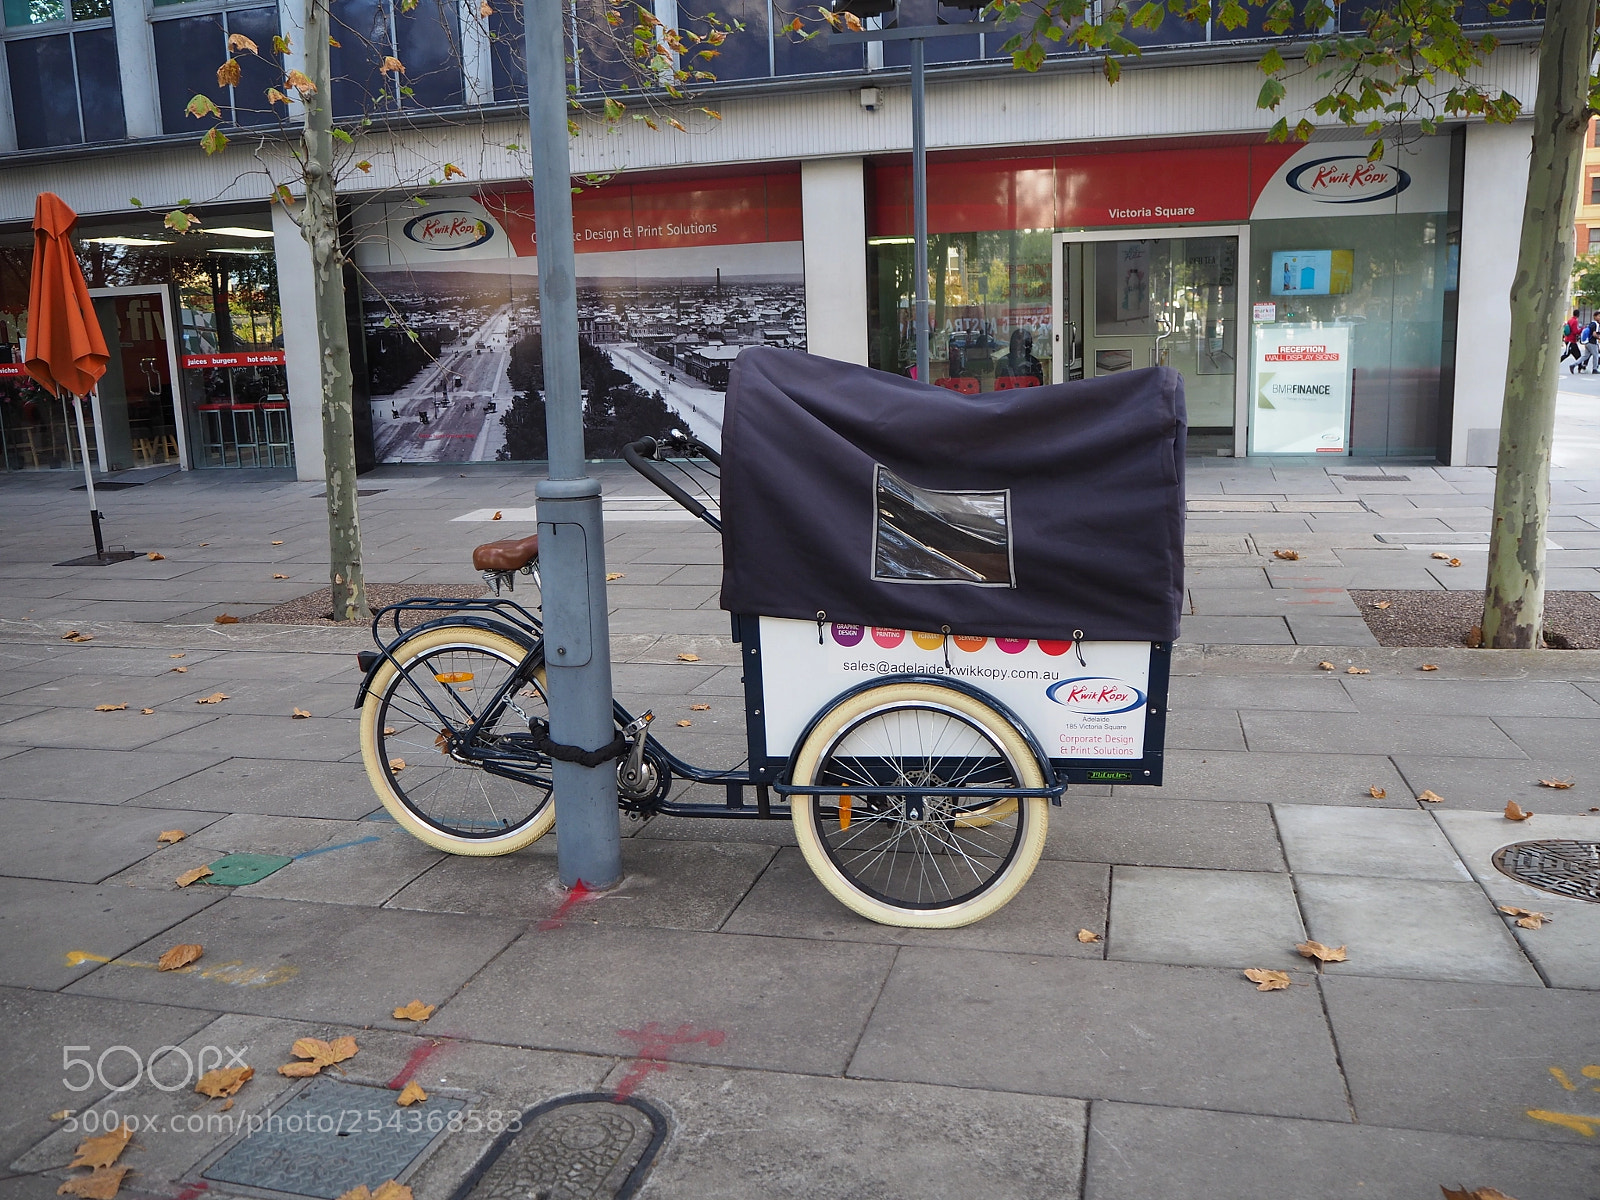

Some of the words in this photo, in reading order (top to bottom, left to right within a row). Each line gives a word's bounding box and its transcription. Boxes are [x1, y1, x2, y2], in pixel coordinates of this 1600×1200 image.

[1311, 165, 1350, 190] Kwik
[1348, 163, 1389, 189] Kopy
[1108, 207, 1152, 218] Victoria
[1154, 206, 1195, 218] Square
[421, 219, 449, 240] Kwik
[585, 228, 619, 242] Design
[623, 227, 632, 238] &
[637, 225, 663, 238] Print
[666, 222, 718, 236] Solutions
[187, 358, 207, 366] juices
[259, 355, 278, 363] chips
[1272, 384, 1330, 395] BMRFINANCE
[843, 660, 1059, 681] sales@adelaide.kwikkopy.com.au
[1067, 685, 1098, 704] Kwik
[1097, 685, 1129, 704] Kopy
[1059, 734, 1102, 744] Corporate
[1105, 734, 1134, 746] Design
[1060, 746, 1068, 754] &
[1070, 746, 1091, 755] Print
[1093, 746, 1134, 756] Solutions
